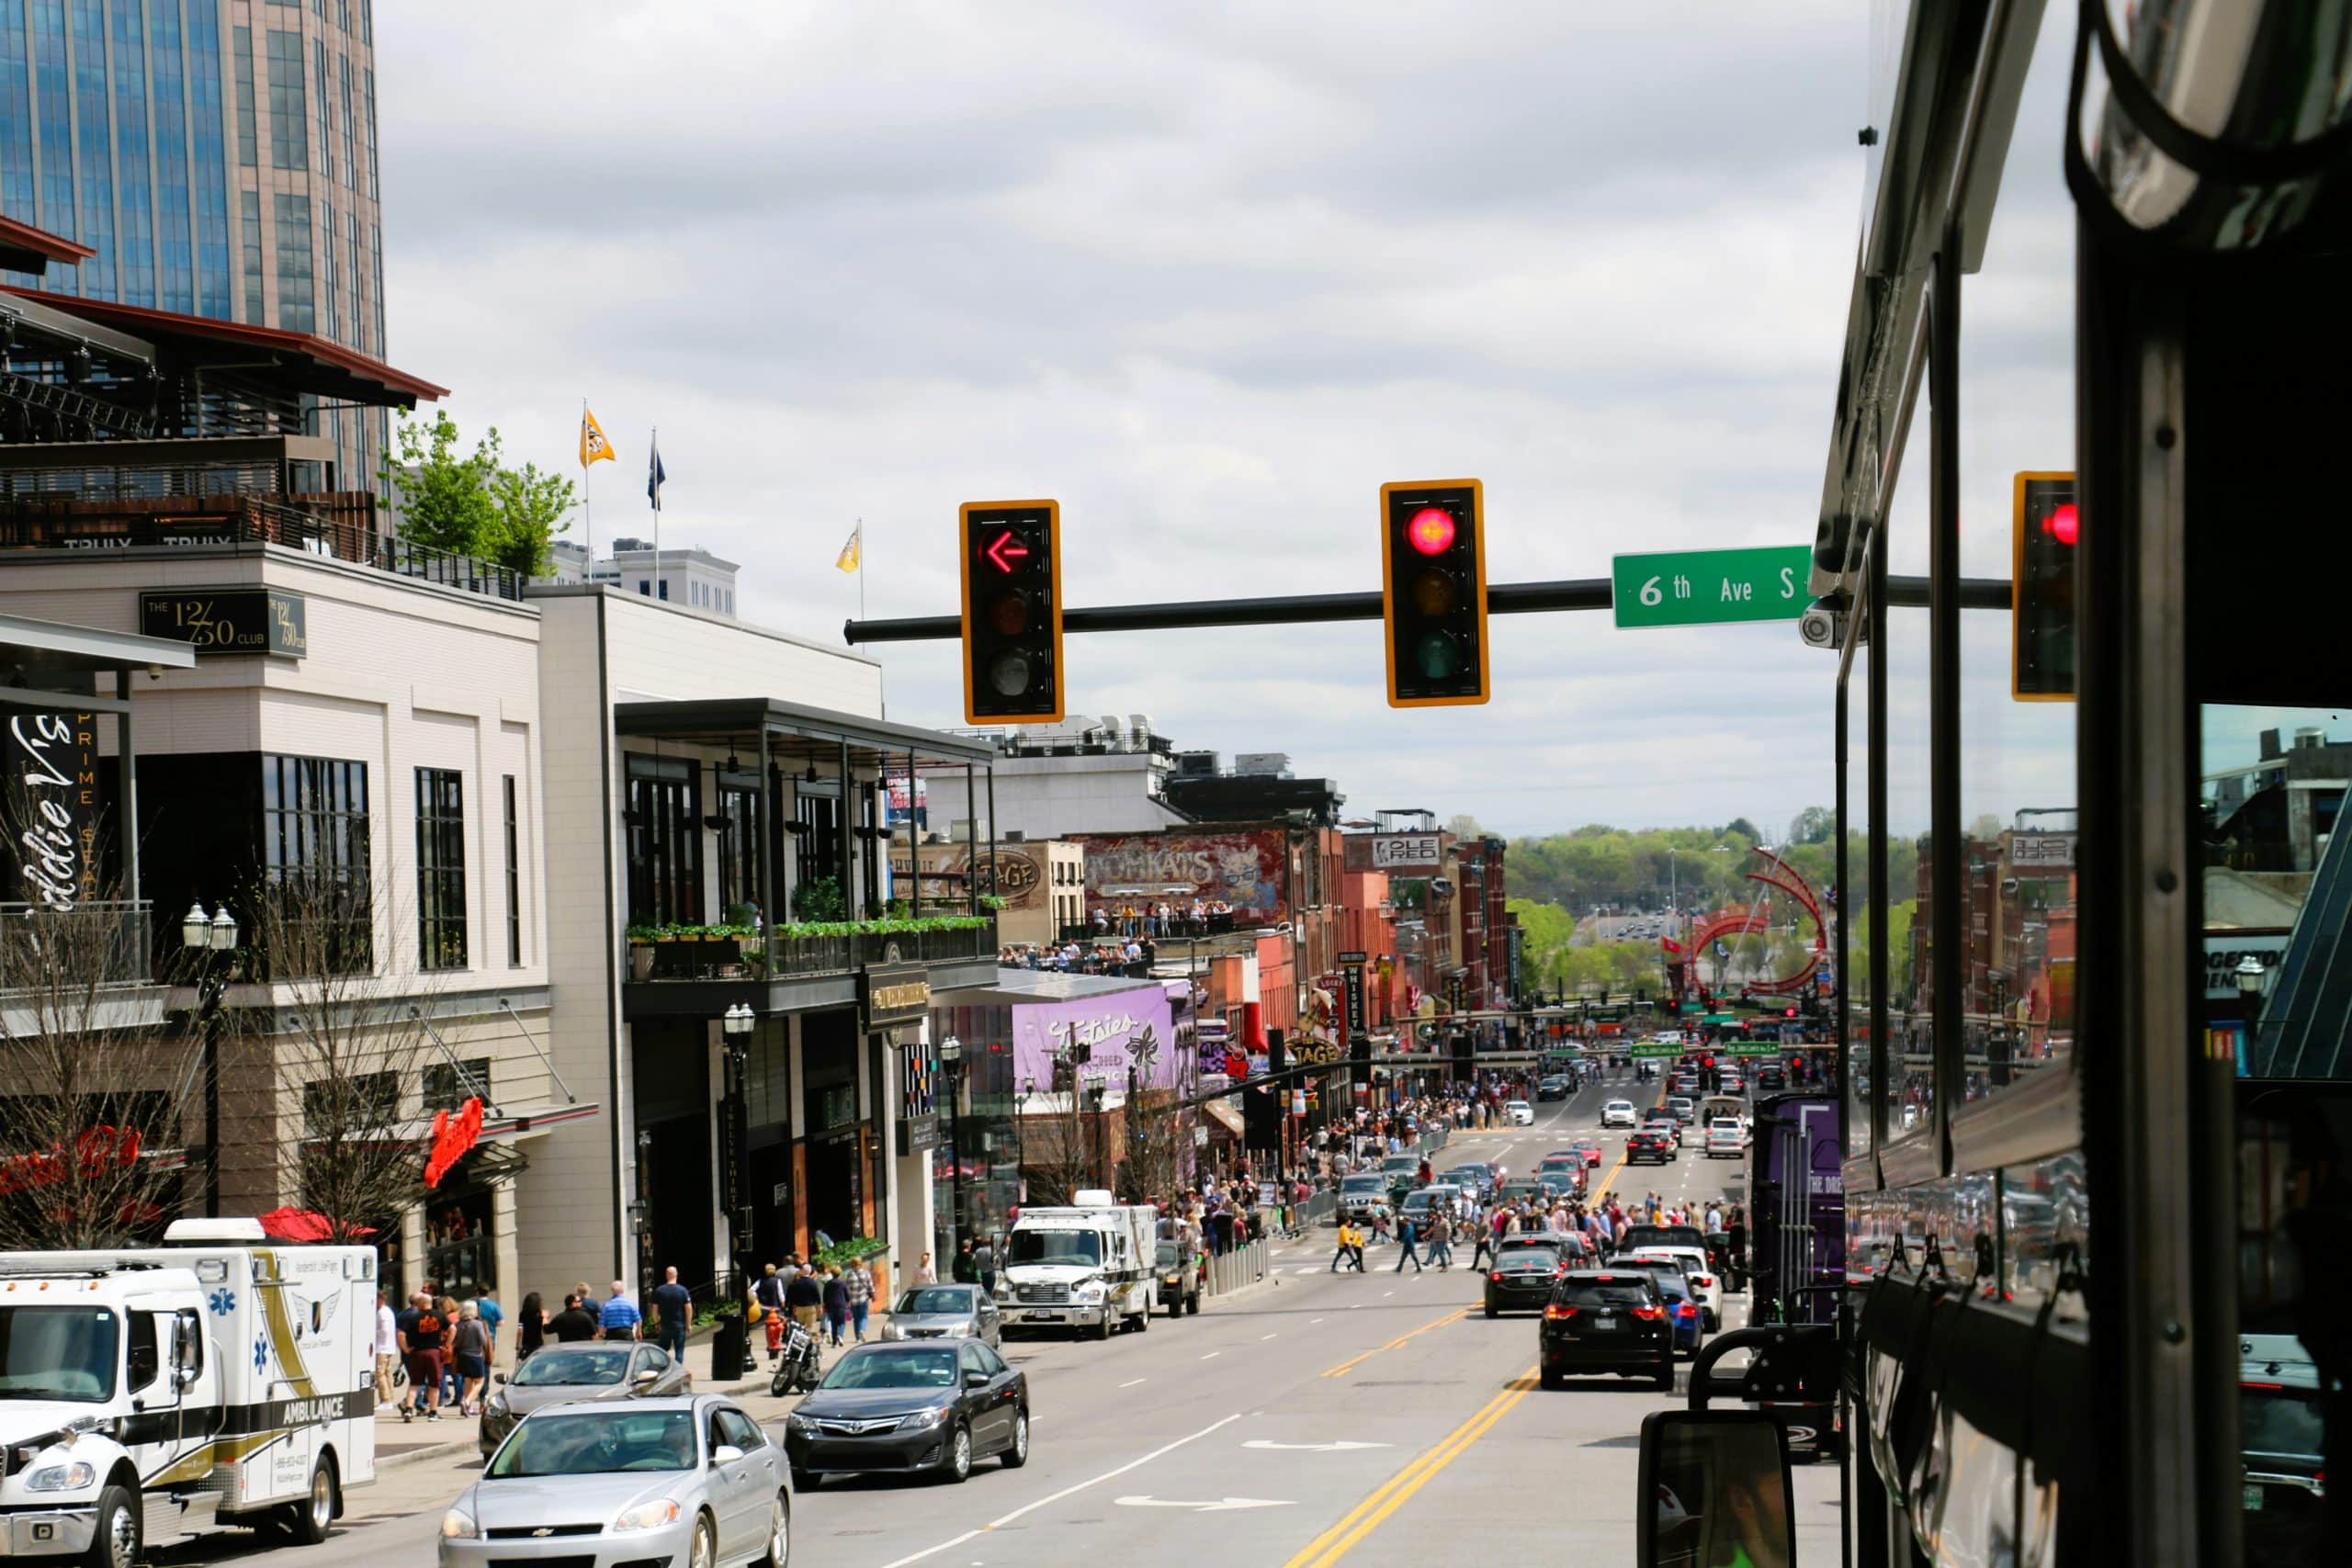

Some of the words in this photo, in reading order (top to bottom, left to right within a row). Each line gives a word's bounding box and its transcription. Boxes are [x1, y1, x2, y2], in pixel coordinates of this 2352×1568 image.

[1720, 578, 1752, 603] Ave
[1780, 567, 1794, 599] S
[149, 602, 168, 613] THE
[237, 633, 265, 645] CLUB
[77, 714, 96, 806] PRIME
[1389, 839, 1435, 850] OLE
[1390, 850, 1436, 860] RED
[1348, 966, 1359, 1028] WHISKEY
[283, 1396, 345, 1425] AMBULANCE
